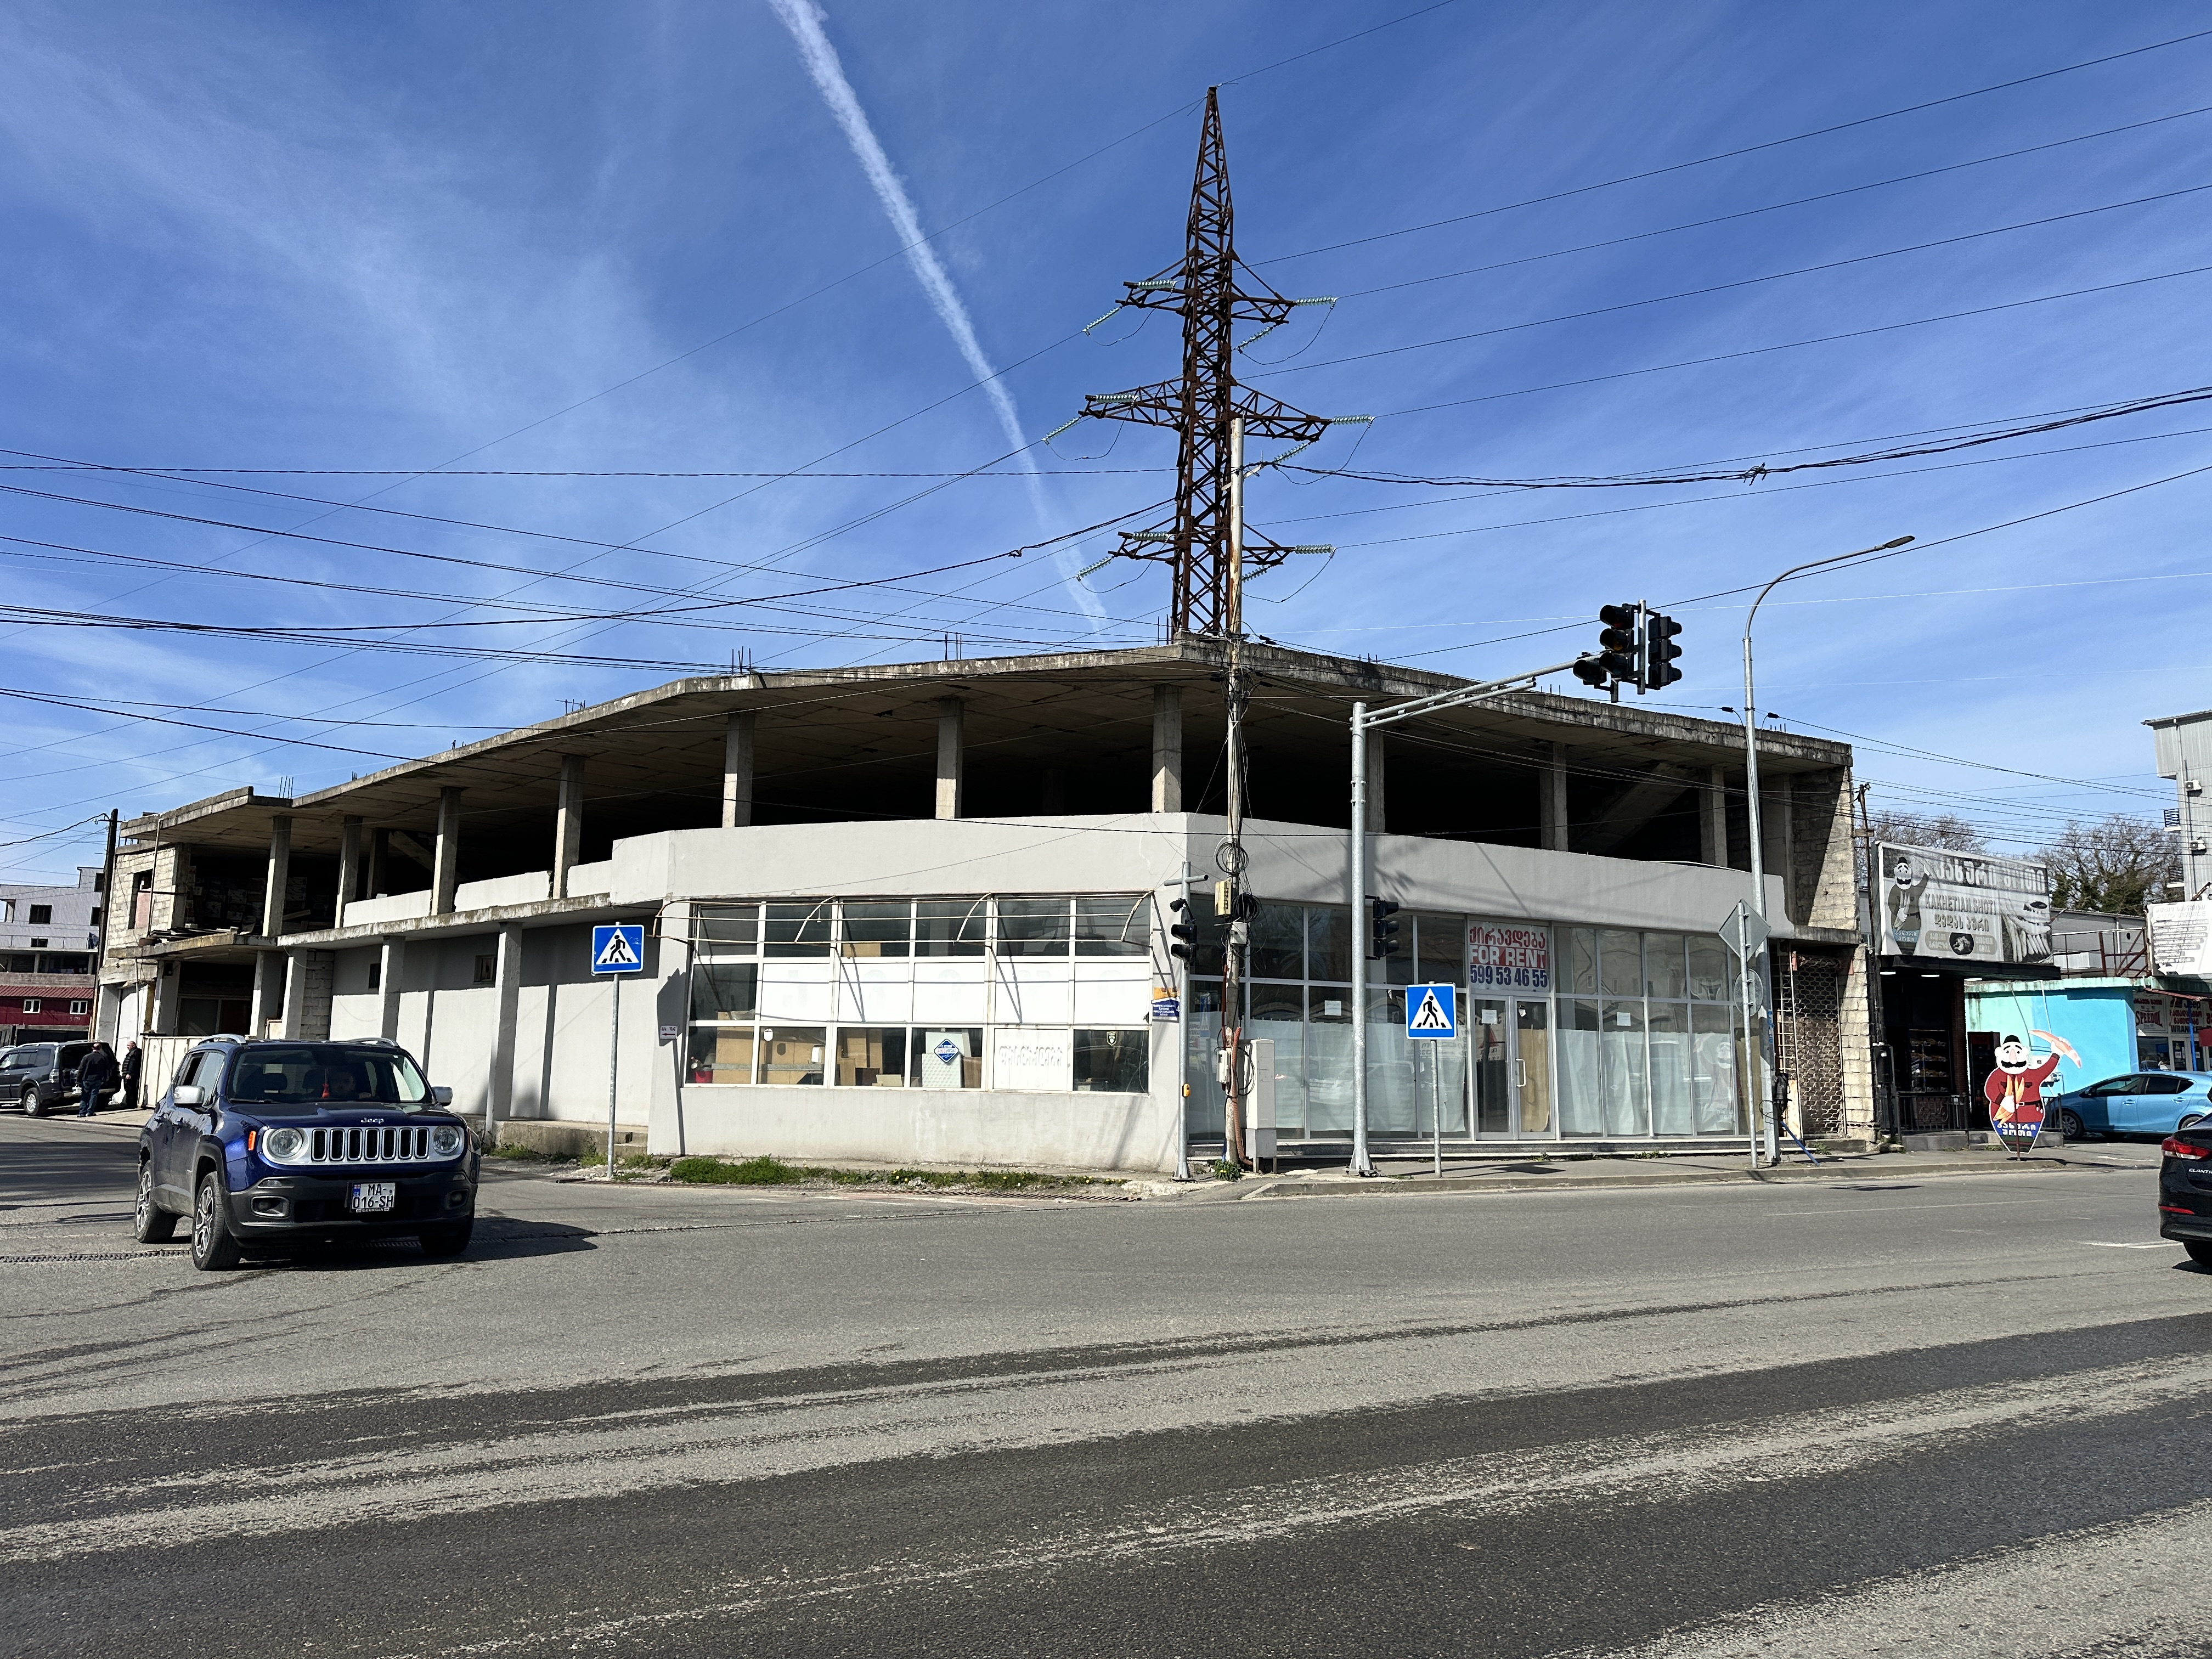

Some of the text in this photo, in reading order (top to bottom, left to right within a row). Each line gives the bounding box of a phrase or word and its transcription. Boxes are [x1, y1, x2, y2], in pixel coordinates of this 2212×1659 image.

[1925, 893, 1996, 915] KAKHETIAN SHOTI
[1966, 917, 1989, 932] პური
[1469, 926, 1545, 949] ქირავდება
[1470, 945, 1545, 968] FOR RENT
[1470, 964, 1548, 988] 599 53 46 55
[2001, 1128, 2032, 1137] შოთი
[353, 1195, 394, 1209] 016-SH
